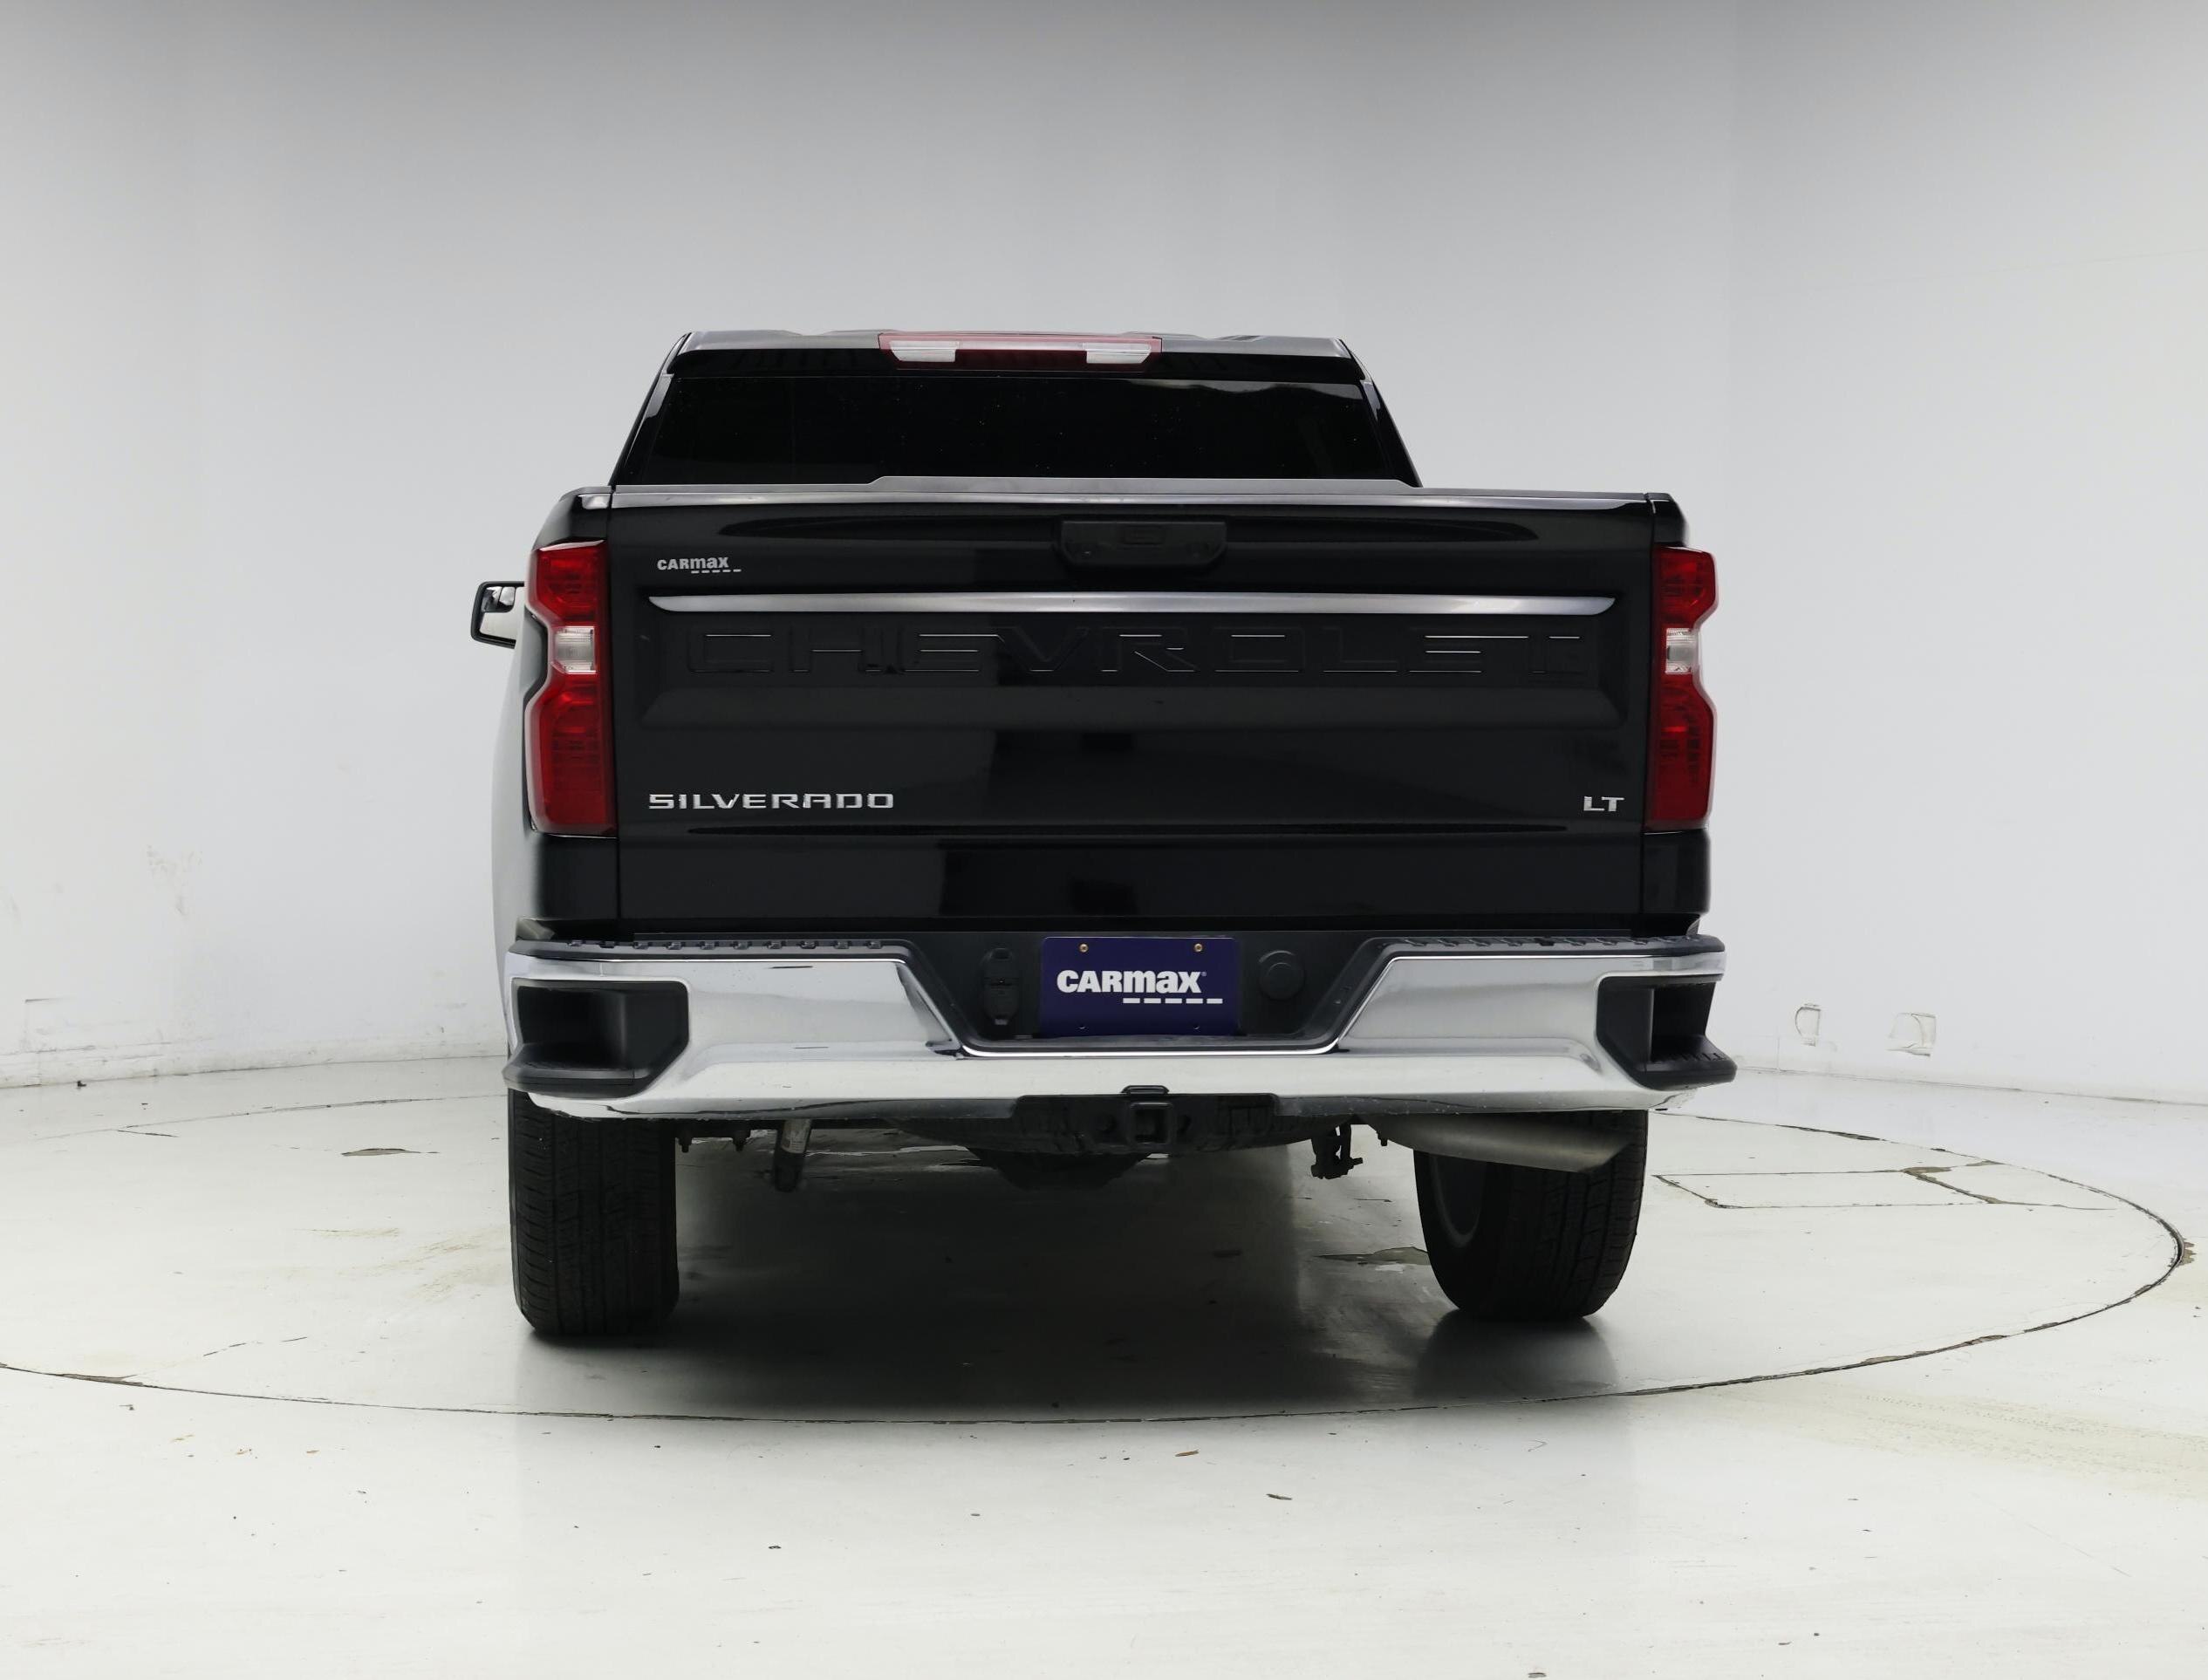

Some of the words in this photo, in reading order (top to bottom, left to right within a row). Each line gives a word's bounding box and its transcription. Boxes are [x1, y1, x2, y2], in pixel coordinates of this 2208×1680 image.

[657, 557, 729, 570] CARmax
[687, 627, 1584, 674] CHEVROLET
[649, 794, 893, 809] SILVERADO
[1583, 796, 1624, 811] LT
